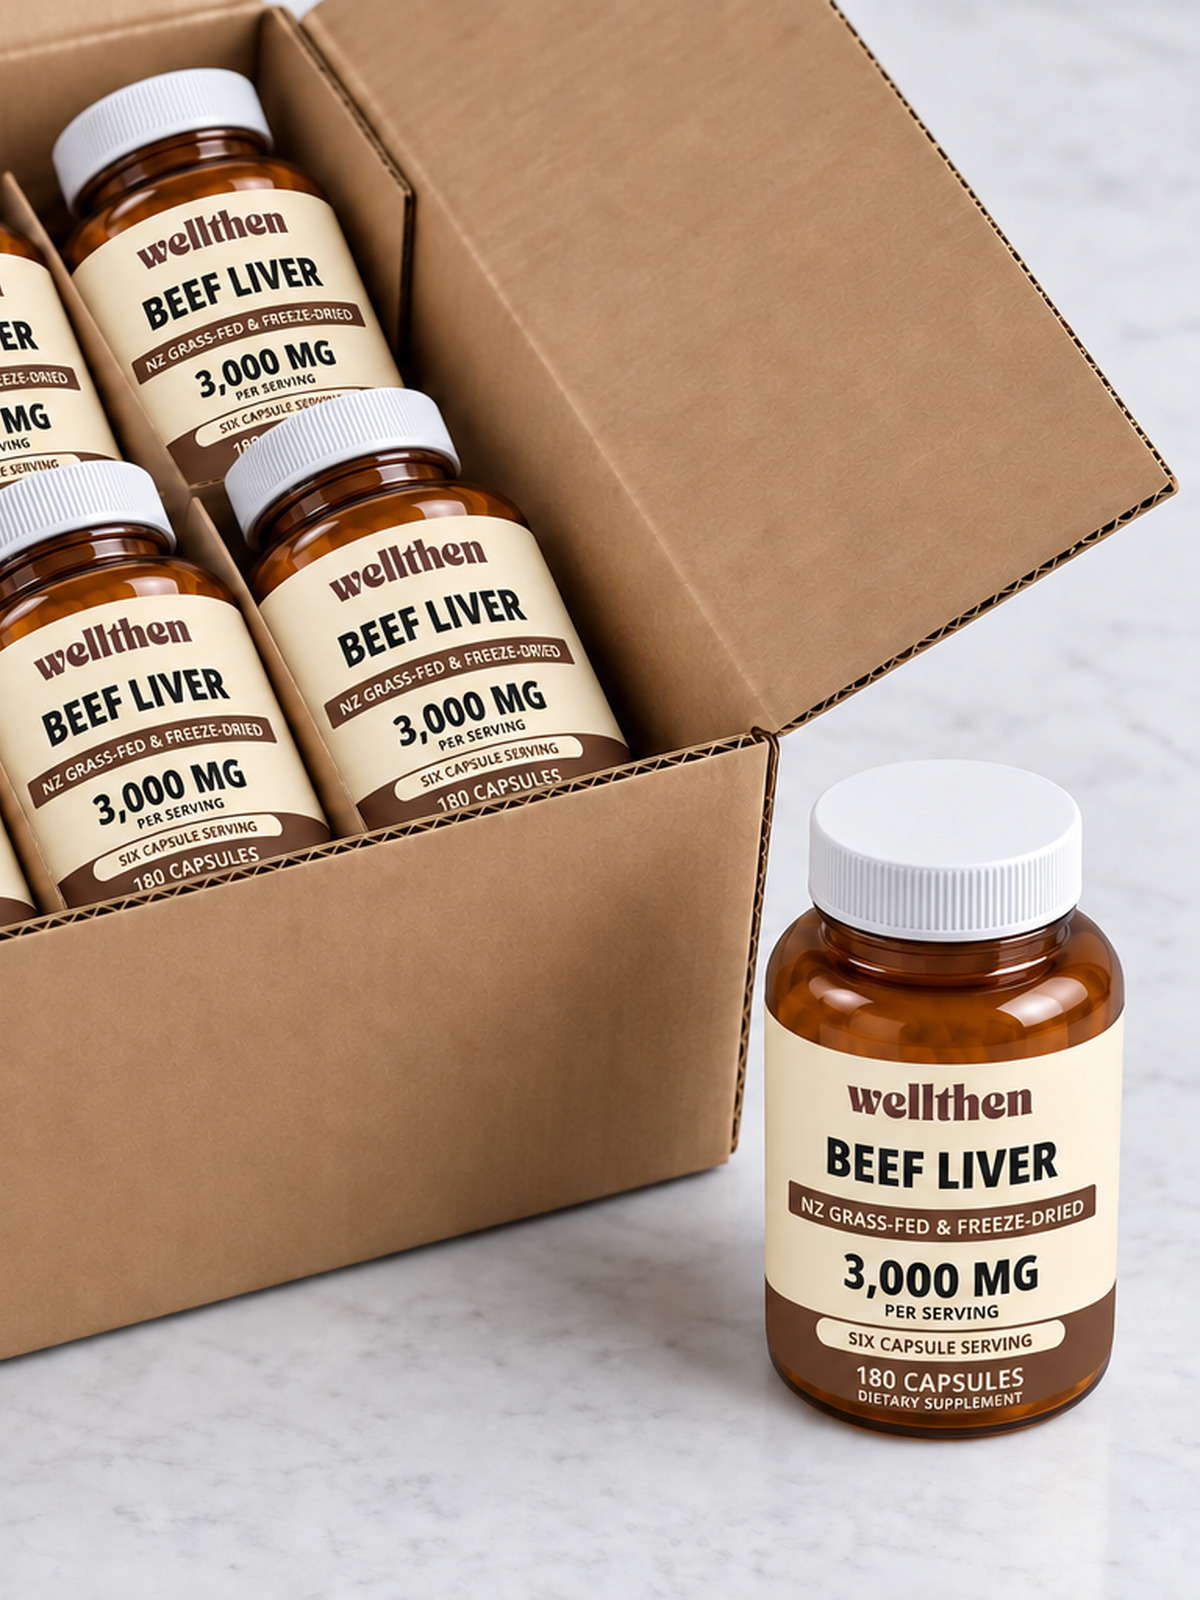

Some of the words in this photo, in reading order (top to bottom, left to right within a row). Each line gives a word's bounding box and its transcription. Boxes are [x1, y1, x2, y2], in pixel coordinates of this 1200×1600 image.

[137, 210, 288, 269] wellthen
[142, 272, 220, 330] BEEF
[227, 258, 323, 297] LIVER
[146, 354, 166, 372] NZ
[168, 323, 244, 360] GRASS-FED
[248, 319, 259, 330] &
[262, 308, 352, 326] FREEZE-DRIED
[195, 349, 279, 398] 3,000
[284, 340, 336, 370] MG
[236, 386, 260, 400] PER
[0, 404, 51, 434] MG
[220, 418, 240, 434] SIX
[329, 539, 488, 602] wellthen
[34, 618, 192, 680] wellthen
[338, 606, 419, 668] BEEF
[425, 590, 527, 633] LIVER
[340, 694, 362, 715] NZ
[364, 661, 444, 701] GRASS-FED
[449, 656, 462, 669] &
[42, 685, 122, 747] BEEF
[128, 669, 230, 712] LIVER
[393, 692, 485, 746] 3,000
[490, 681, 546, 715] MG
[439, 735, 464, 750] PER
[467, 719, 525, 742] SERVING
[42, 774, 63, 795] NZ
[66, 740, 146, 780] GRASS-FED
[150, 735, 163, 748] &
[165, 723, 262, 744] FREEZE-DRIED
[420, 770, 443, 787] SIX
[445, 752, 502, 777] CAPSULE
[504, 743, 558, 761] SERVING
[93, 770, 184, 825] 3,000
[190, 760, 246, 793] MG
[438, 790, 469, 811] 180
[474, 768, 562, 800] CAPSULES
[137, 812, 163, 829] PER
[165, 798, 224, 820] SERVING
[119, 849, 140, 866] SIX
[143, 830, 200, 856] CAPSULE
[202, 821, 257, 839] SERVING
[134, 869, 164, 891] 180
[170, 847, 259, 878] CAPSULES
[848, 1084, 1032, 1121] wellthen
[828, 1137, 924, 1188] BEEF
[939, 1142, 1058, 1189] LIVER
[802, 1197, 824, 1218] NZ
[830, 1206, 929, 1234] GRASS-FED
[937, 1220, 950, 1234] &
[958, 1200, 1084, 1234] FREEZE-DRIED
[844, 1254, 958, 1298] 3,000
[974, 1255, 1038, 1297] MG
[886, 1304, 916, 1320] PER
[923, 1305, 998, 1320] SERVING
[849, 1332, 874, 1348] SIX
[880, 1337, 955, 1354] CAPSULE
[961, 1334, 1032, 1354] SERVING
[858, 1366, 895, 1389] 180
[904, 1368, 1023, 1392] CAPSULES
[859, 1390, 920, 1408] DIETARY
[925, 1392, 1022, 1410] SUPPLEMENT
